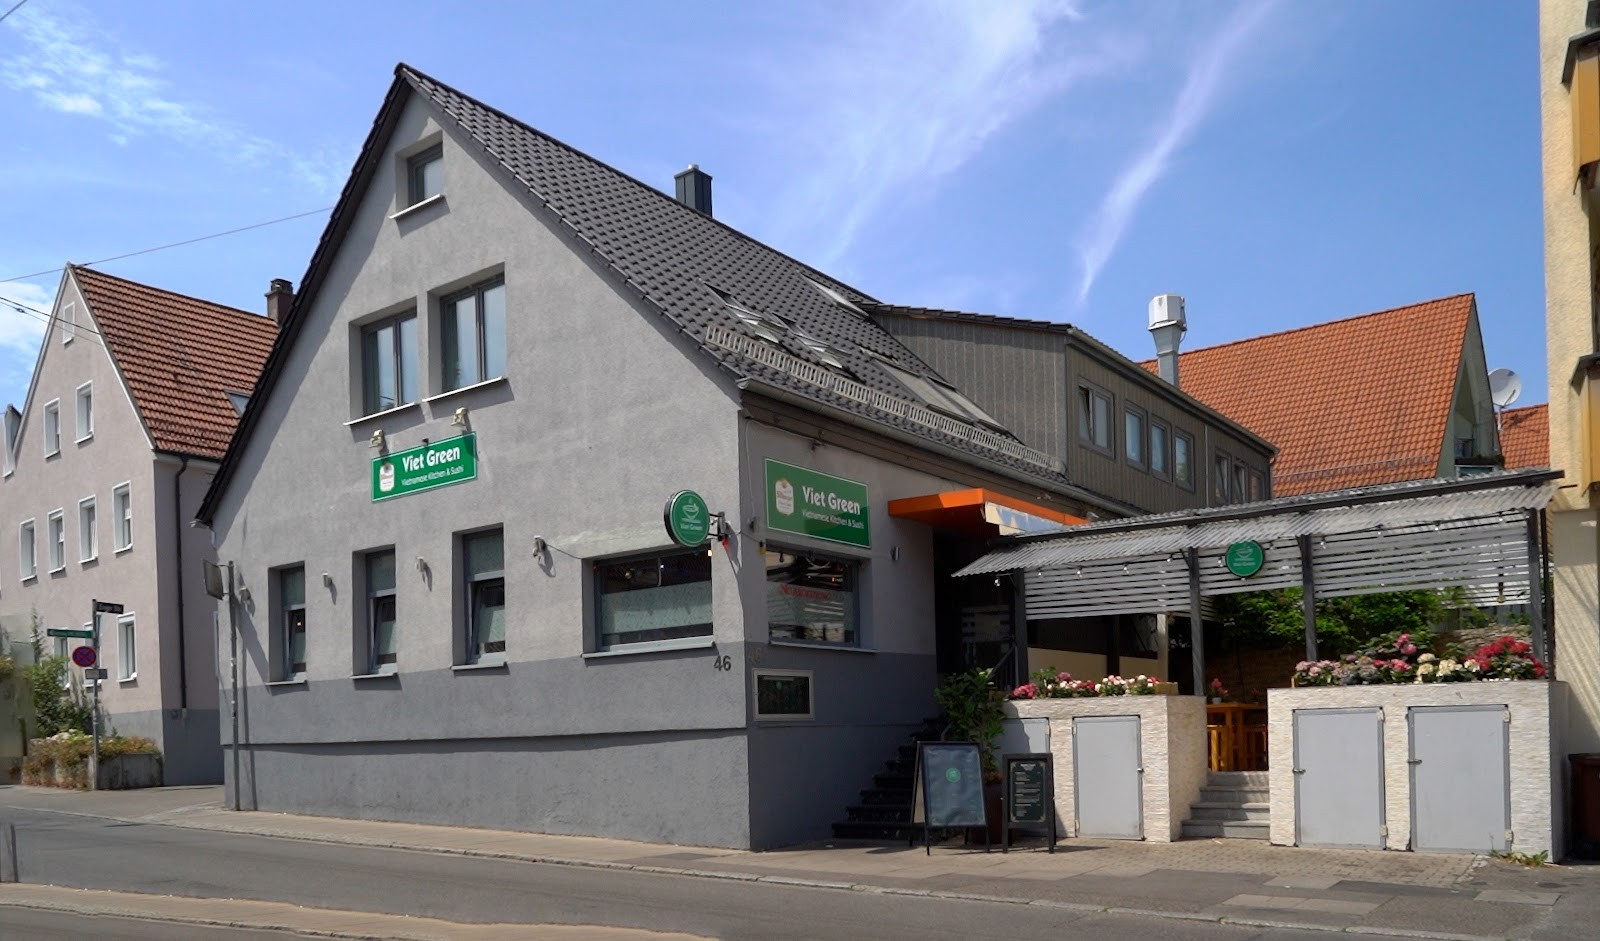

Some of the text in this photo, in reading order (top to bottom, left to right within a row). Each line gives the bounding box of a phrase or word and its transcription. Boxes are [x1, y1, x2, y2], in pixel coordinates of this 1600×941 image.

[402, 447, 460, 472] Viet Green
[802, 485, 826, 507] Viet
[828, 493, 861, 515] Green
[714, 655, 731, 671] 46
